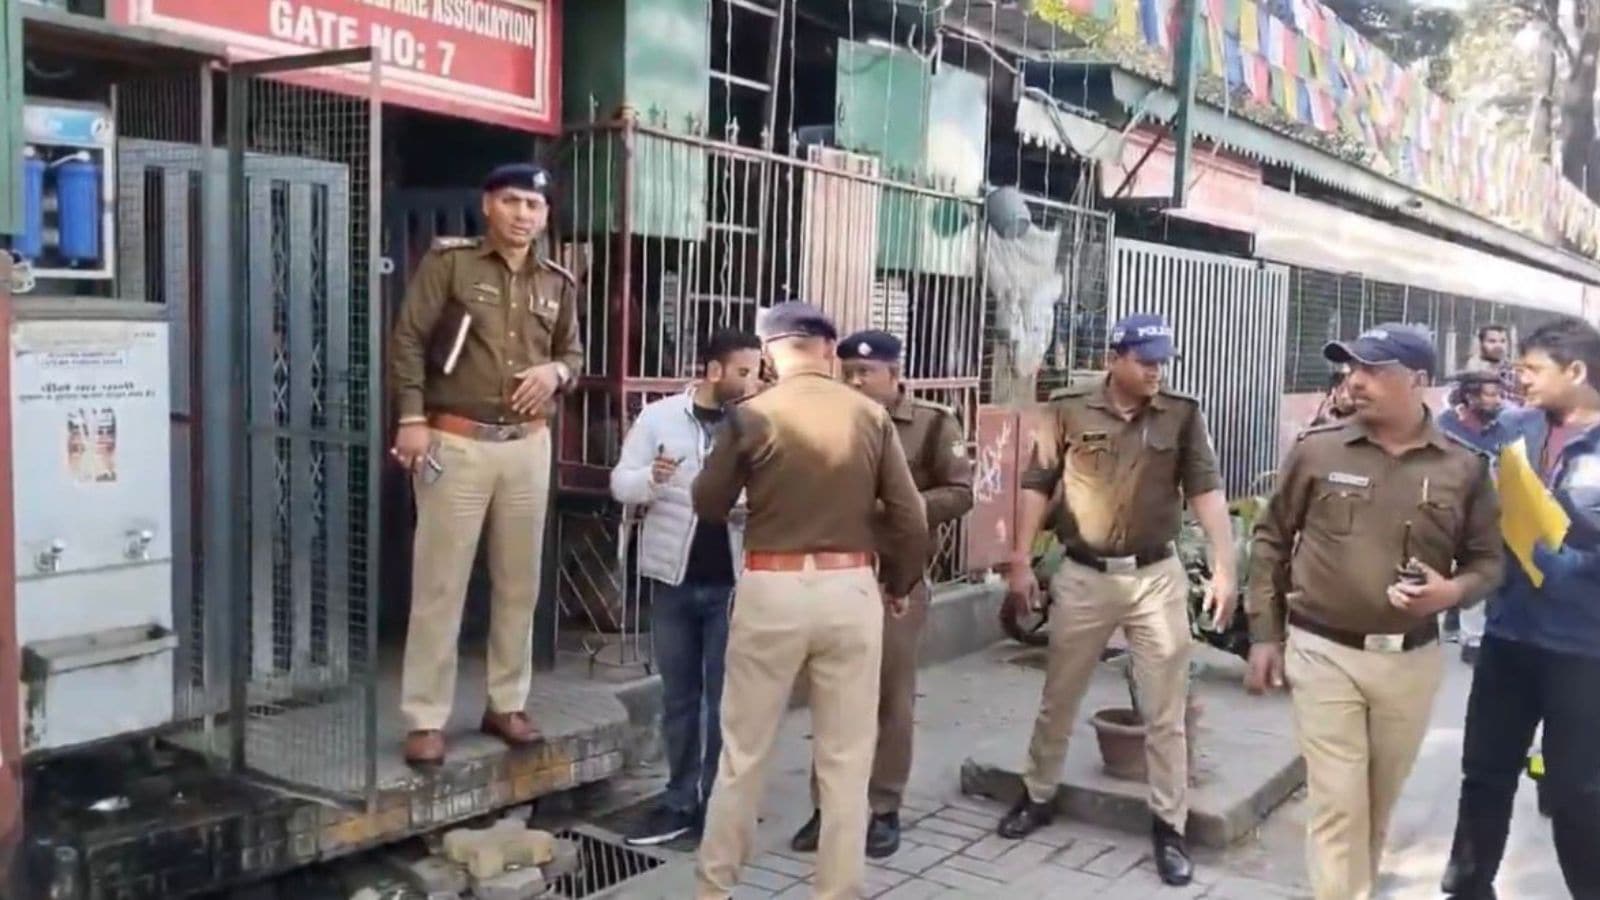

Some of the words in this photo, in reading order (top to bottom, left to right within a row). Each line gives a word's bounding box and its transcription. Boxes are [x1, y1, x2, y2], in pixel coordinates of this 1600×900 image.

[269, 0, 359, 50] GATE
[370, 21, 426, 70] NO:
[437, 40, 456, 76] 7
[432, 0, 534, 49] ASSOCIATION
